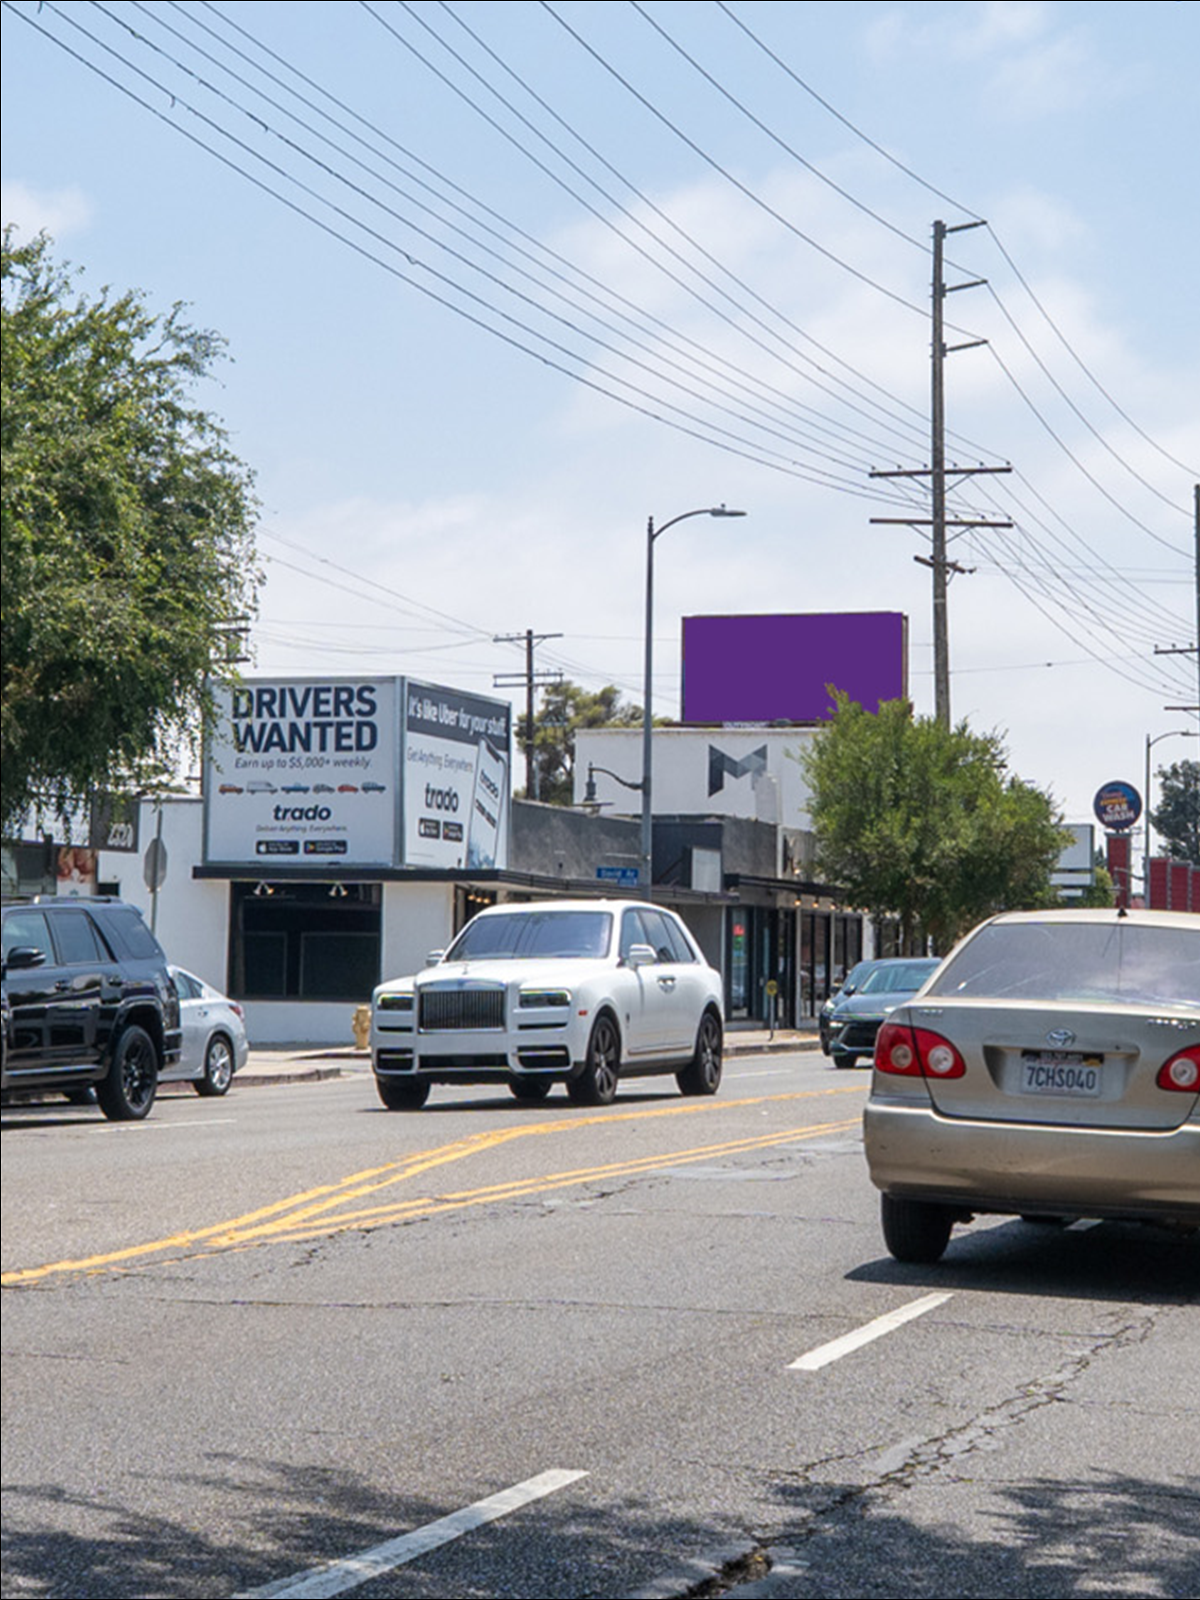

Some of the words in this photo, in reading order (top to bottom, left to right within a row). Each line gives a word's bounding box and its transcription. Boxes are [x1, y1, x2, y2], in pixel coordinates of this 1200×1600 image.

[232, 685, 377, 719] DRIVERS
[233, 720, 378, 753] WANTED
[235, 757, 259, 769] Earn
[261, 759, 275, 770] up
[277, 758, 287, 769] to
[288, 757, 331, 770] $5,000+
[425, 782, 459, 813] trado
[273, 805, 332, 821] trado
[1102, 810, 1135, 822] WASH
[1106, 804, 1128, 813] CAR
[1027, 1066, 1097, 1090] 7CHS040
